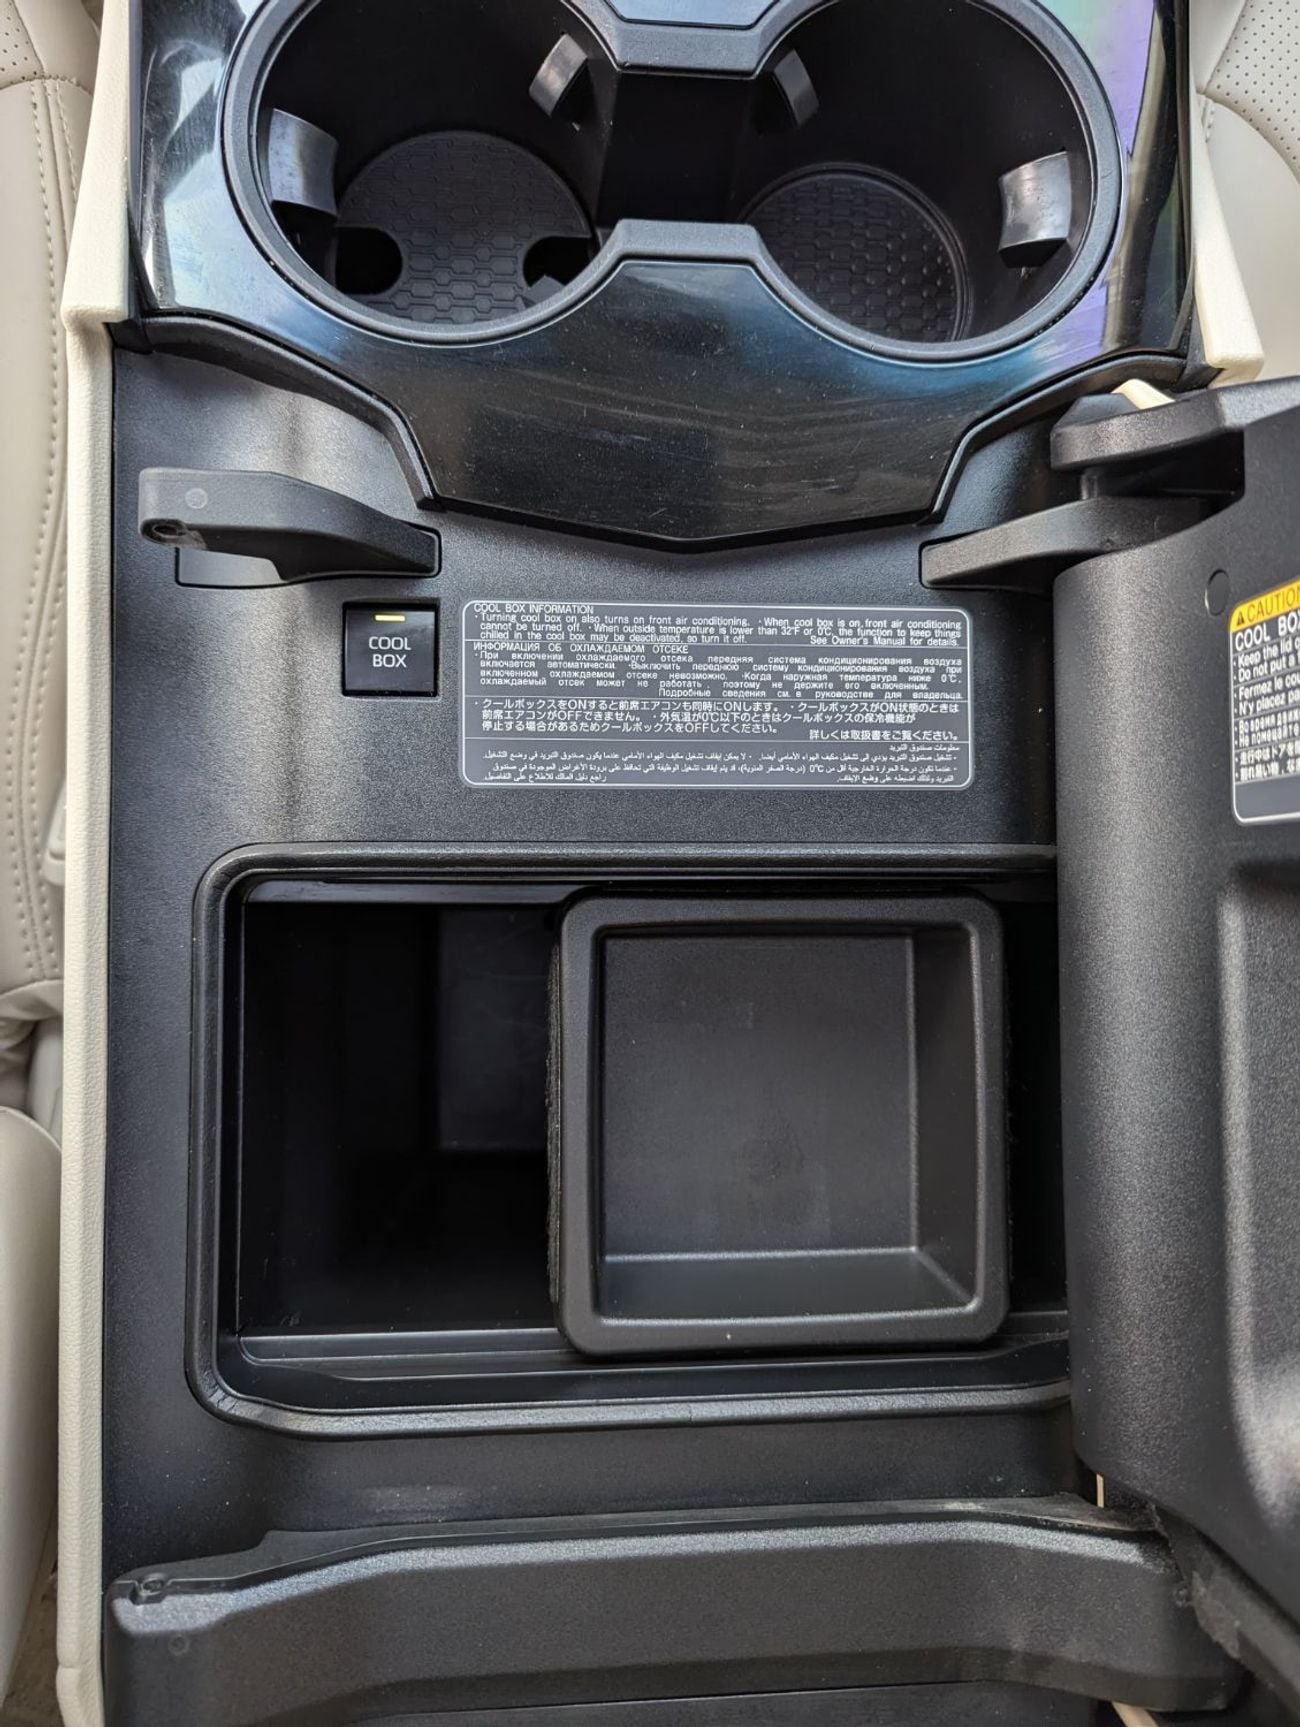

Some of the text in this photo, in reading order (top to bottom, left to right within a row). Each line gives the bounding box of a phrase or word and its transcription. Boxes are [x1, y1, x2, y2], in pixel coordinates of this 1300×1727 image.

[473, 603, 594, 614] COOL BOX INFORMATION
[481, 613, 517, 624] Turning
[521, 613, 540, 622] cool
[544, 614, 561, 622] box
[582, 614, 600, 623] also
[604, 615, 629, 624] turns
[650, 615, 671, 624] front
[676, 616, 688, 625] air
[692, 616, 750, 628] conditioning.
[516, 623, 528, 631] be
[532, 623, 561, 631] turned
[764, 618, 789, 626] When
[794, 618, 813, 627] cool
[817, 618, 834, 627] box
[838, 619, 845, 627] is
[865, 619, 887, 628] front
[891, 619, 904, 628] air
[907, 620, 962, 631] conditioning
[480, 631, 509, 639] chilled
[514, 631, 522, 639] in
[546, 632, 564, 640] cool
[570, 632, 586, 640] box
[590, 634, 609, 643] may
[614, 633, 625, 641] be
[702, 634, 720, 642] turn
[724, 634, 729, 642] it
[733, 635, 747, 643] off.
[594, 624, 619, 632] When
[660, 625, 715, 635] temperature
[719, 626, 726, 634] is
[730, 626, 754, 634] lower
[758, 626, 777, 634] than
[839, 627, 853, 635] the
[857, 628, 892, 636] function
[897, 628, 906, 636] to
[910, 628, 932, 639] keep
[935, 629, 962, 639] things
[1235, 622, 1271, 651] COOL
[368, 636, 412, 650] COOL
[810, 636, 959, 646] See Owner's Manual for details.
[473, 643, 689, 654] ИНФОРМАЦИЯ ОБ ОХЛАЖДАЕМОМ ОТСЕКЕ
[1238, 651, 1260, 668] Keep
[1263, 646, 1279, 660] the
[1281, 636, 1292, 654] lid
[372, 654, 407, 668] BOX
[1238, 668, 1251, 682] Do
[1253, 662, 1268, 678] not
[1270, 656, 1286, 674] put
[1239, 681, 1272, 700] Fermez
[1274, 676, 1282, 690] le
[1256, 692, 1285, 713] placez
